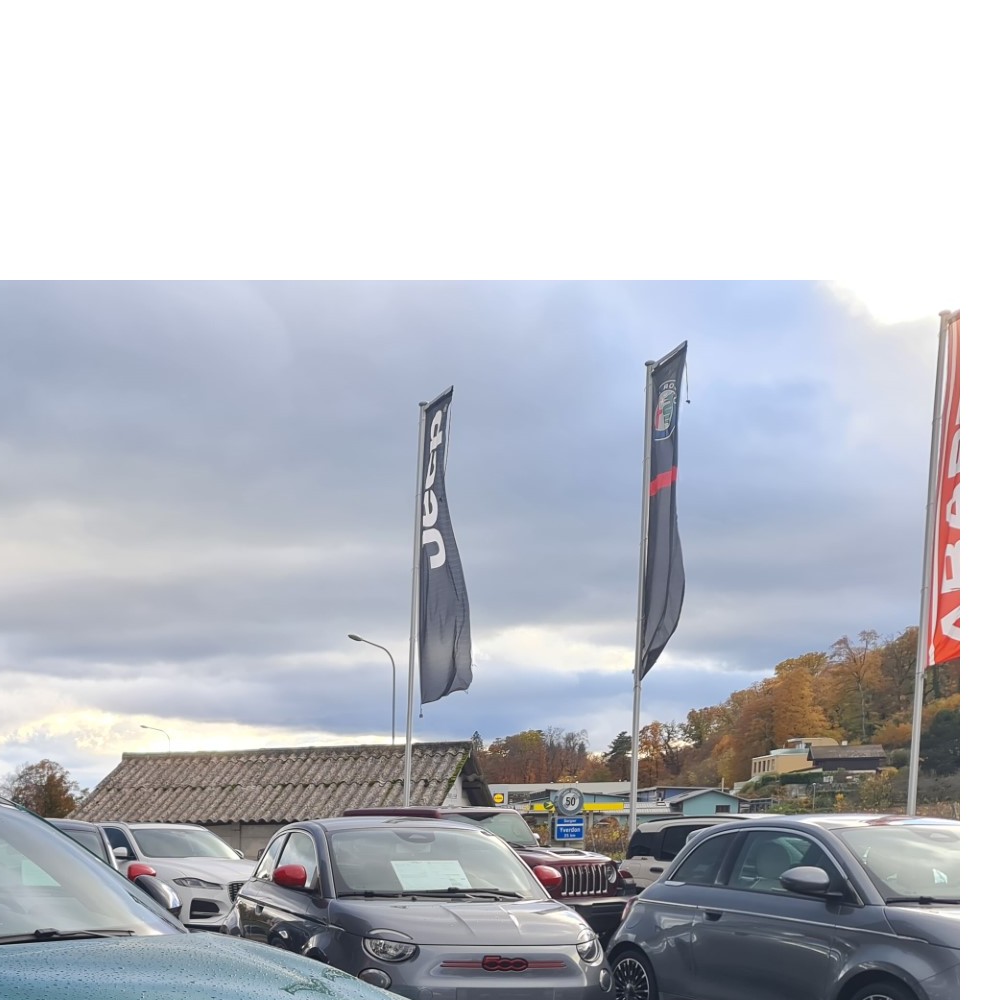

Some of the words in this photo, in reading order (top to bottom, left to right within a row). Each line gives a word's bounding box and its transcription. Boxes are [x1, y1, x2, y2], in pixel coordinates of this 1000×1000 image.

[422, 410, 446, 569] Jeep
[565, 797, 576, 806] 50
[482, 955, 529, 971] 500
